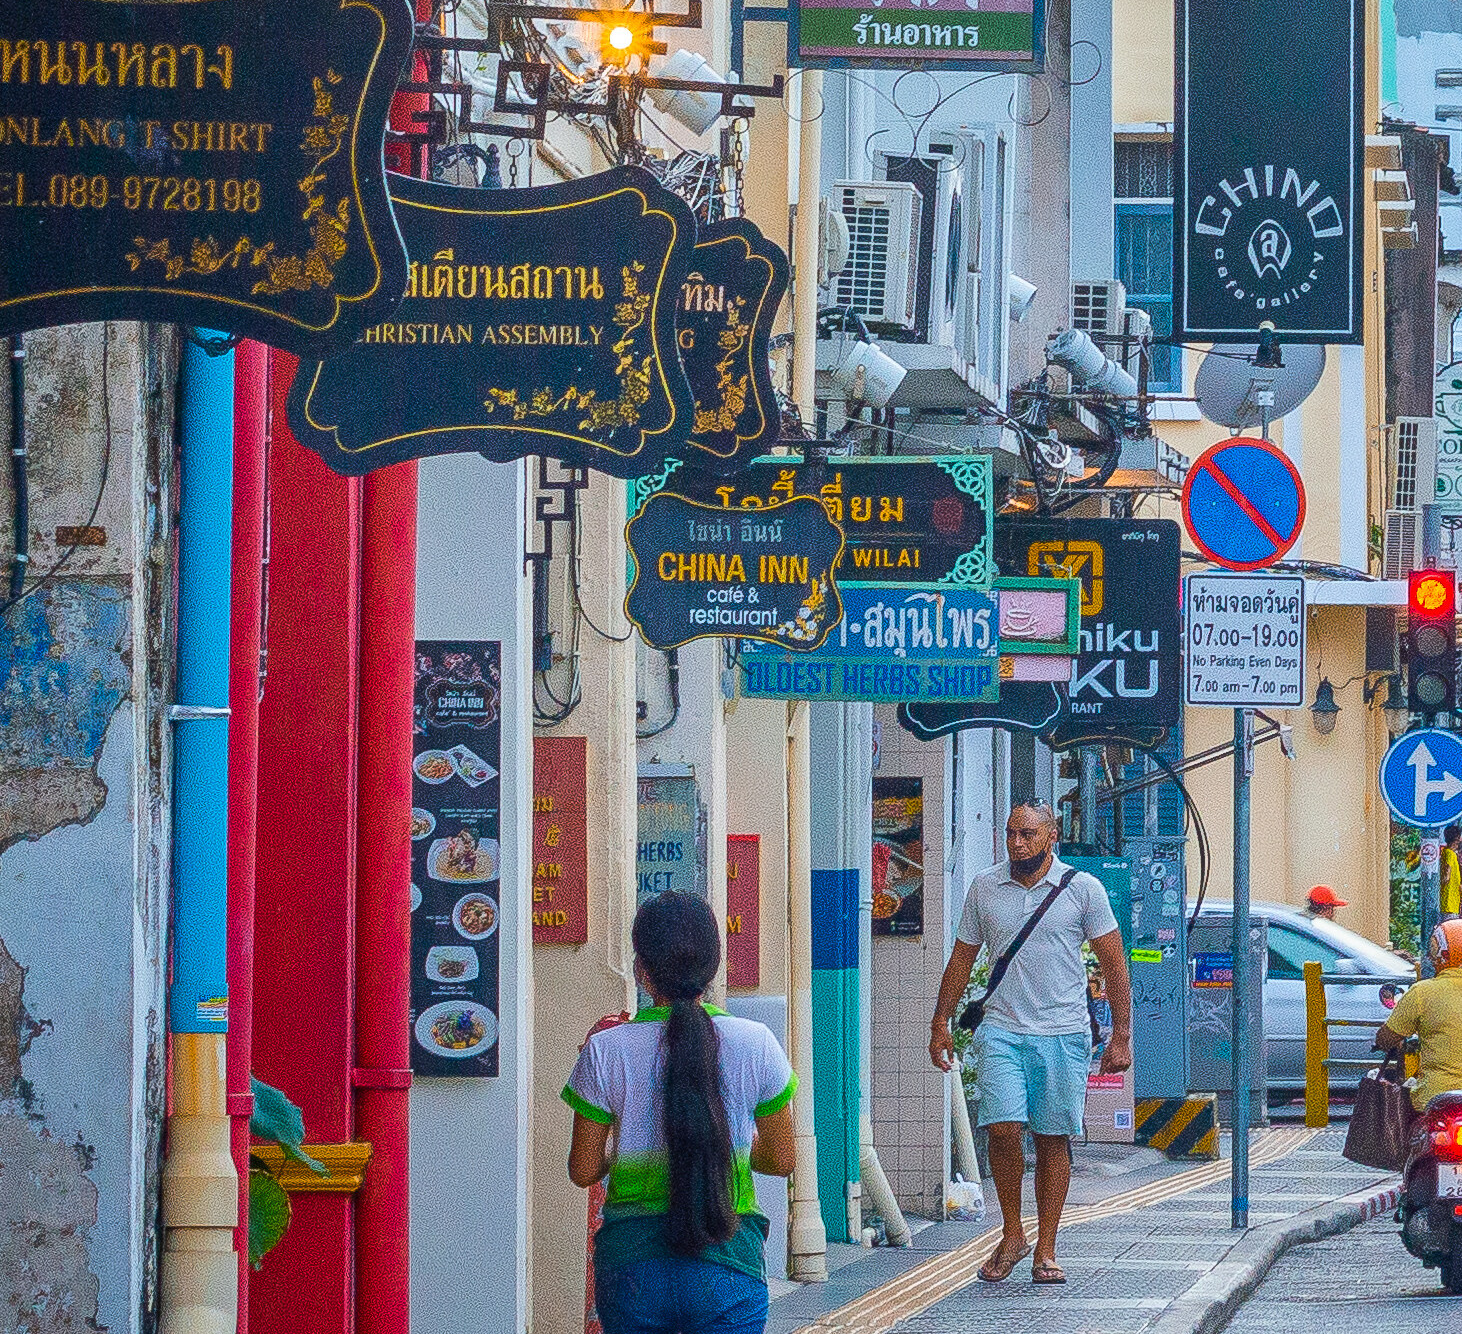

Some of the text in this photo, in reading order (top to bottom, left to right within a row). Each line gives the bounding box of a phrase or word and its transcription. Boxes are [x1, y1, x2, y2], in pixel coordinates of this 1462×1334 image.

[851, 13, 980, 48] ร้านอาหาร
[171, 120, 273, 153] SHIRT
[1195, 164, 1344, 239] CHINO
[481, 324, 604, 346] ASSEMBLY
[657, 551, 809, 584] CHINA INN
[853, 548, 921, 569] WILAI
[706, 586, 760, 605] café &
[1192, 586, 1300, 625] ห้ามจอดวันคู่
[688, 606, 778, 627] restaurant
[1192, 623, 1299, 649] 07.00-19.00
[1192, 655, 1298, 670] No Parking Even Days
[927, 664, 993, 696] SHOP
[1279, 681, 1298, 696] pm
[637, 842, 684, 862] HERBS
